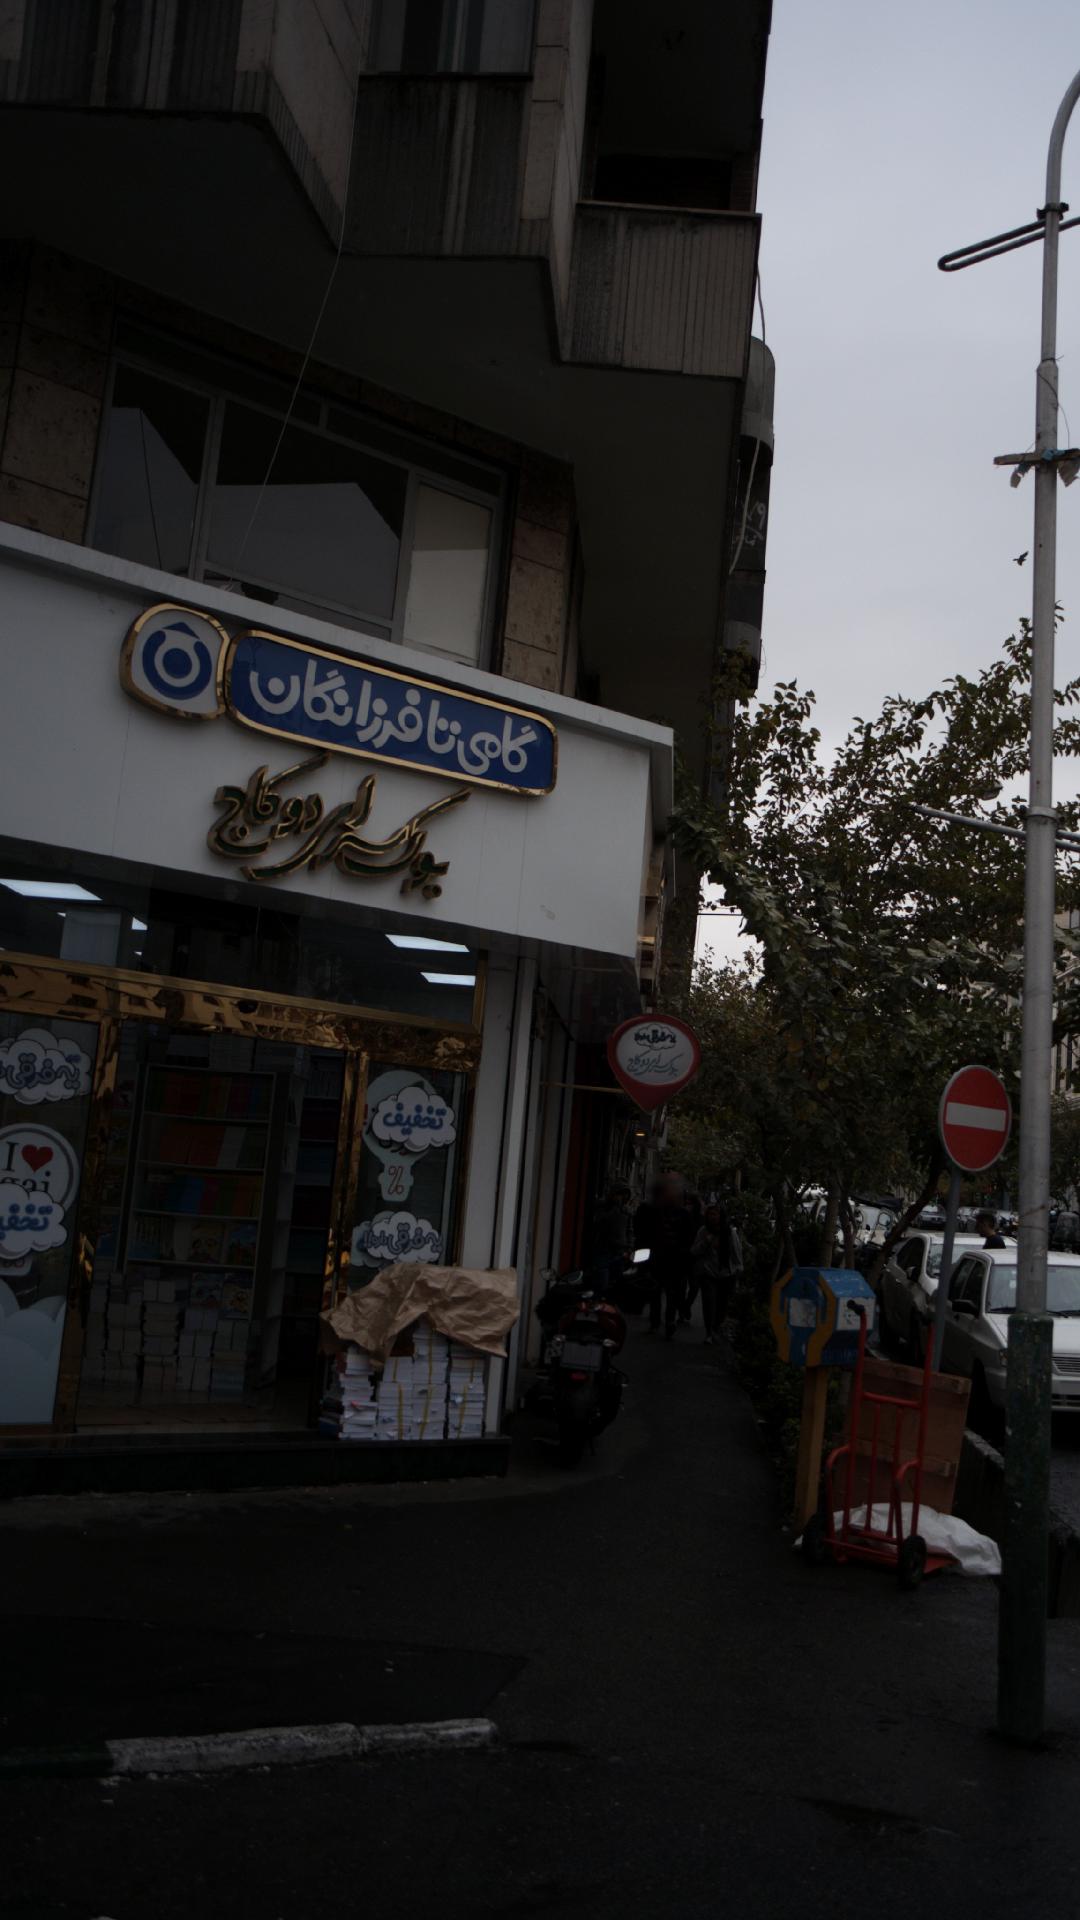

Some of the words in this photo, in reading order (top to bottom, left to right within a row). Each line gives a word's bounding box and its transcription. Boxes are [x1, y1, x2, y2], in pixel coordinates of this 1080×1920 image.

[249, 658, 423, 749] فرزانگان
[427, 699, 462, 754] تا
[457, 715, 538, 775] گامی
[383, 1103, 447, 1135] تخفیف
[3, 1141, 18, 1171] I
[0, 1203, 53, 1240] تخفی
